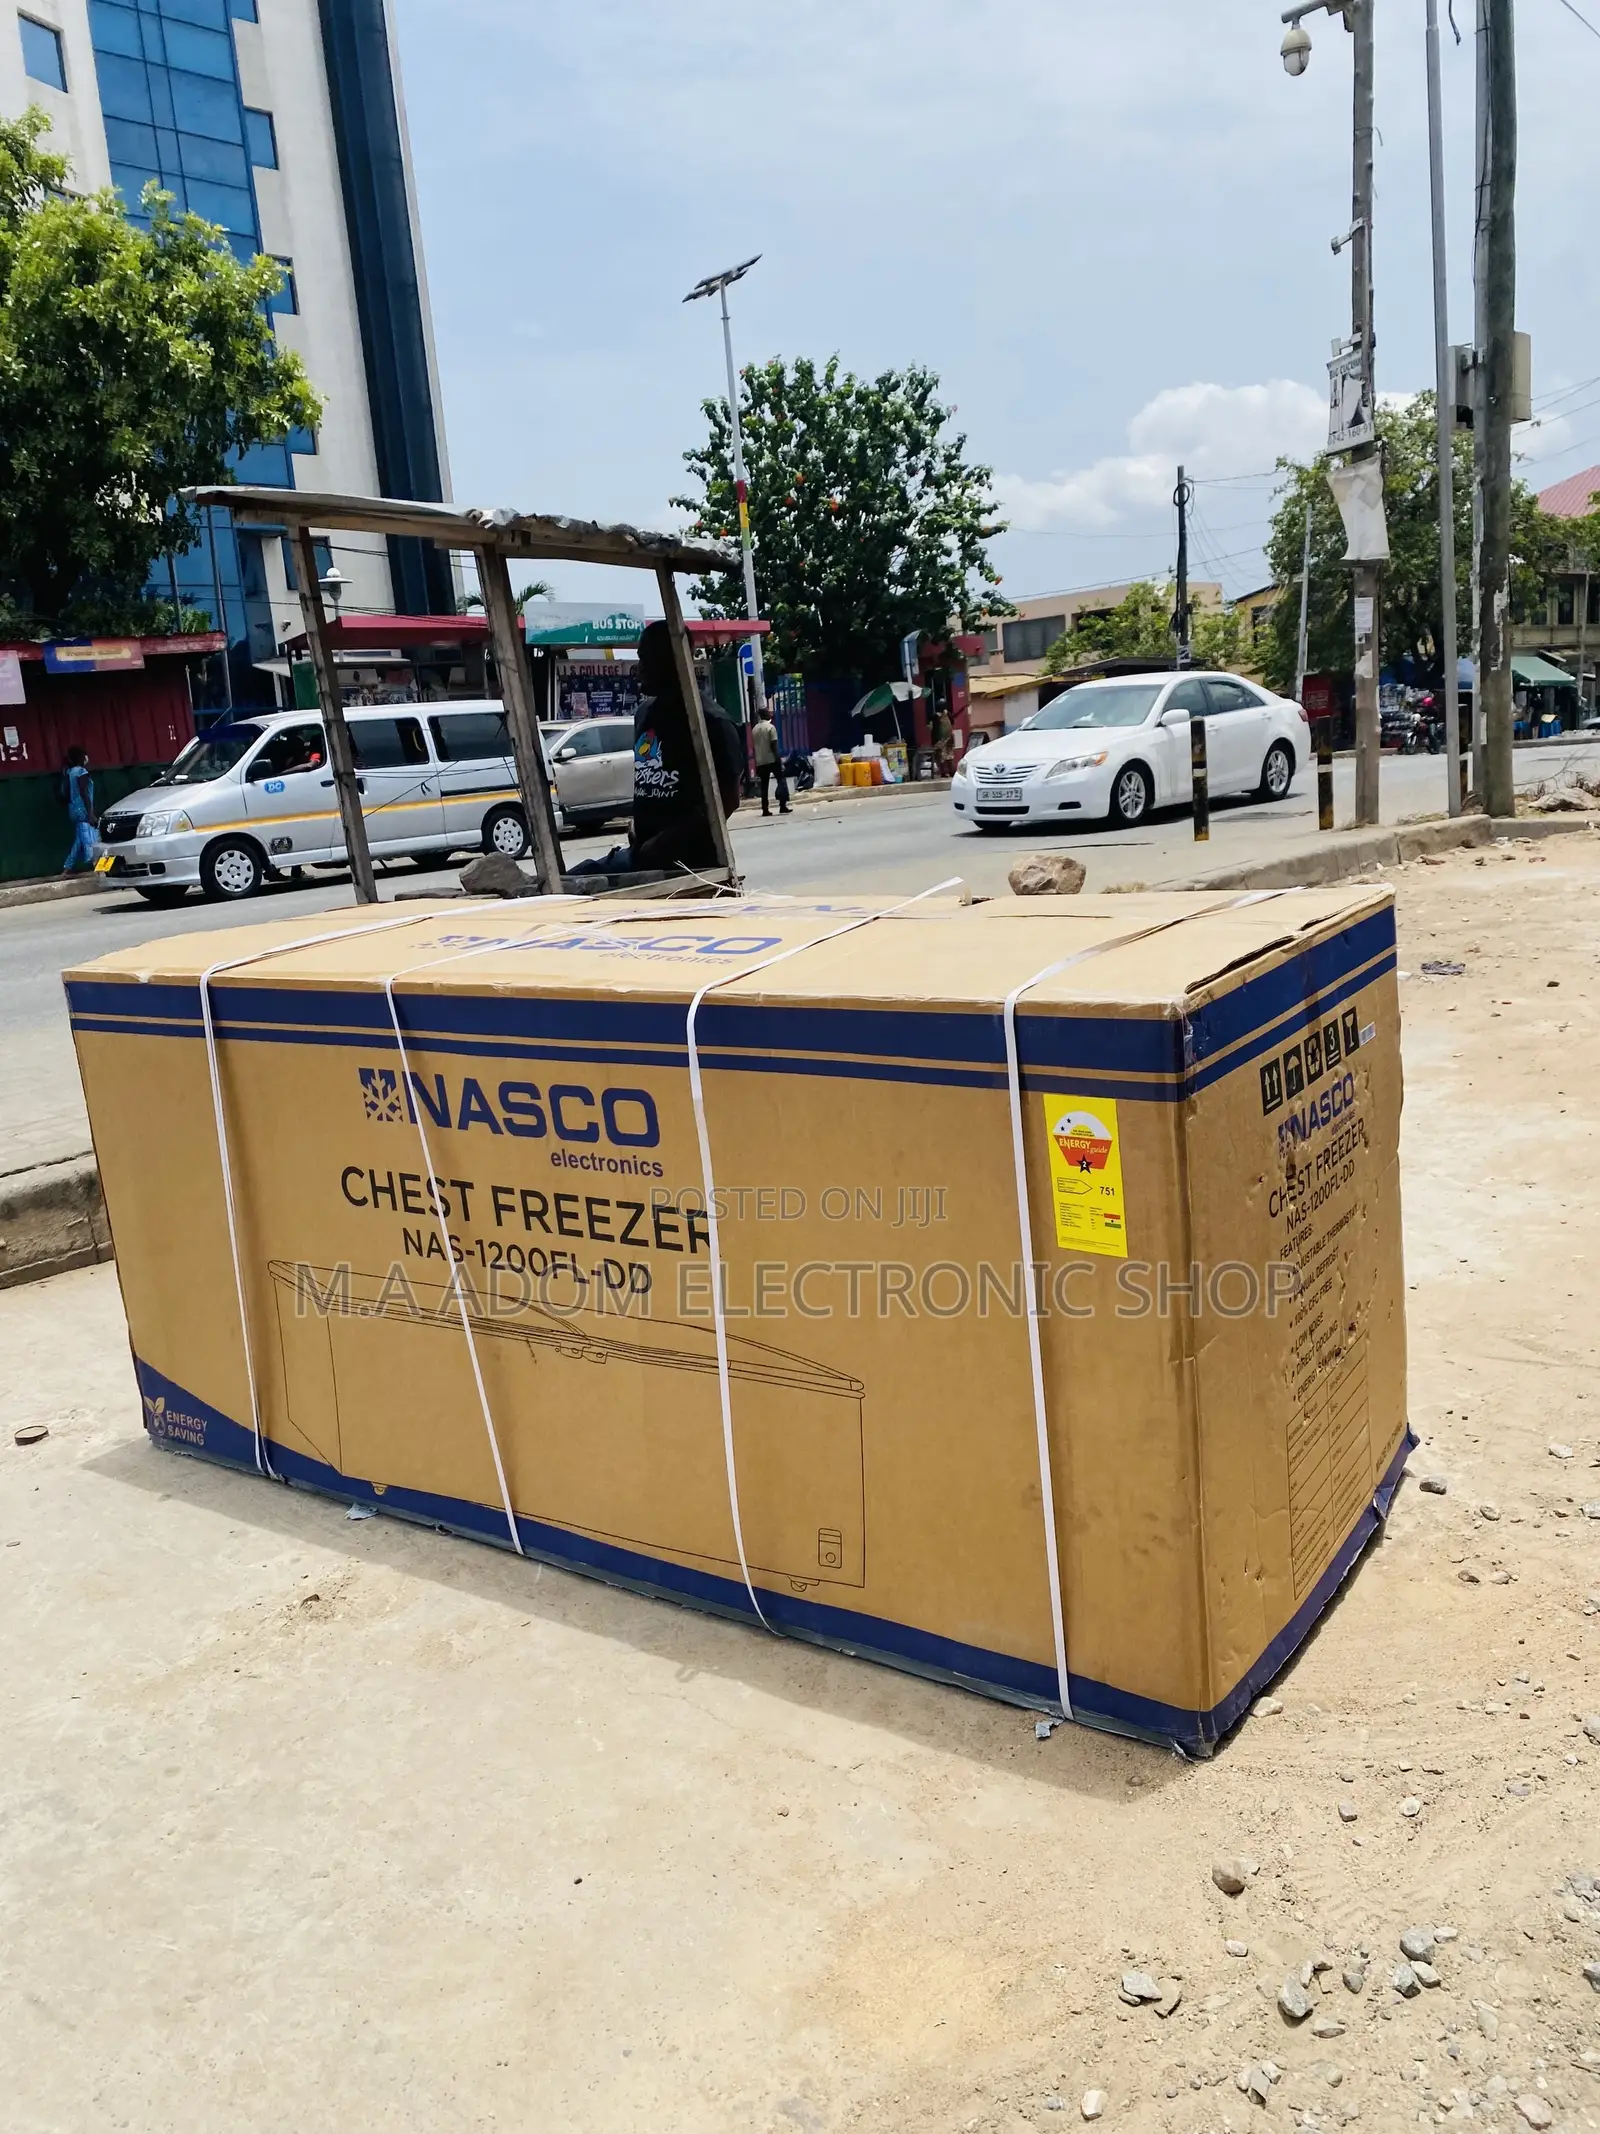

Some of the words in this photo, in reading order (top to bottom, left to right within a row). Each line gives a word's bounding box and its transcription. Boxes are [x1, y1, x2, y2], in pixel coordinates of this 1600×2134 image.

[593, 619, 613, 630] BUS
[616, 618, 641, 630] STOP
[580, 664, 620, 676] COLLEGE
[402, 1072, 660, 1148] NASCO
[1290, 1071, 1355, 1143] NASCO
[1059, 1136, 1092, 1150] ENERGY
[550, 1148, 664, 1178] electronics
[1269, 1161, 1312, 1218] CHEST
[1316, 1117, 1366, 1181] FREEZER
[341, 1165, 475, 1222] CHEST
[1099, 1186, 1116, 1196] 751
[402, 1227, 653, 1295] NAS-1200FL-DD
[166, 1410, 208, 1432] ENERGY
[167, 1424, 205, 1446] SAVING
